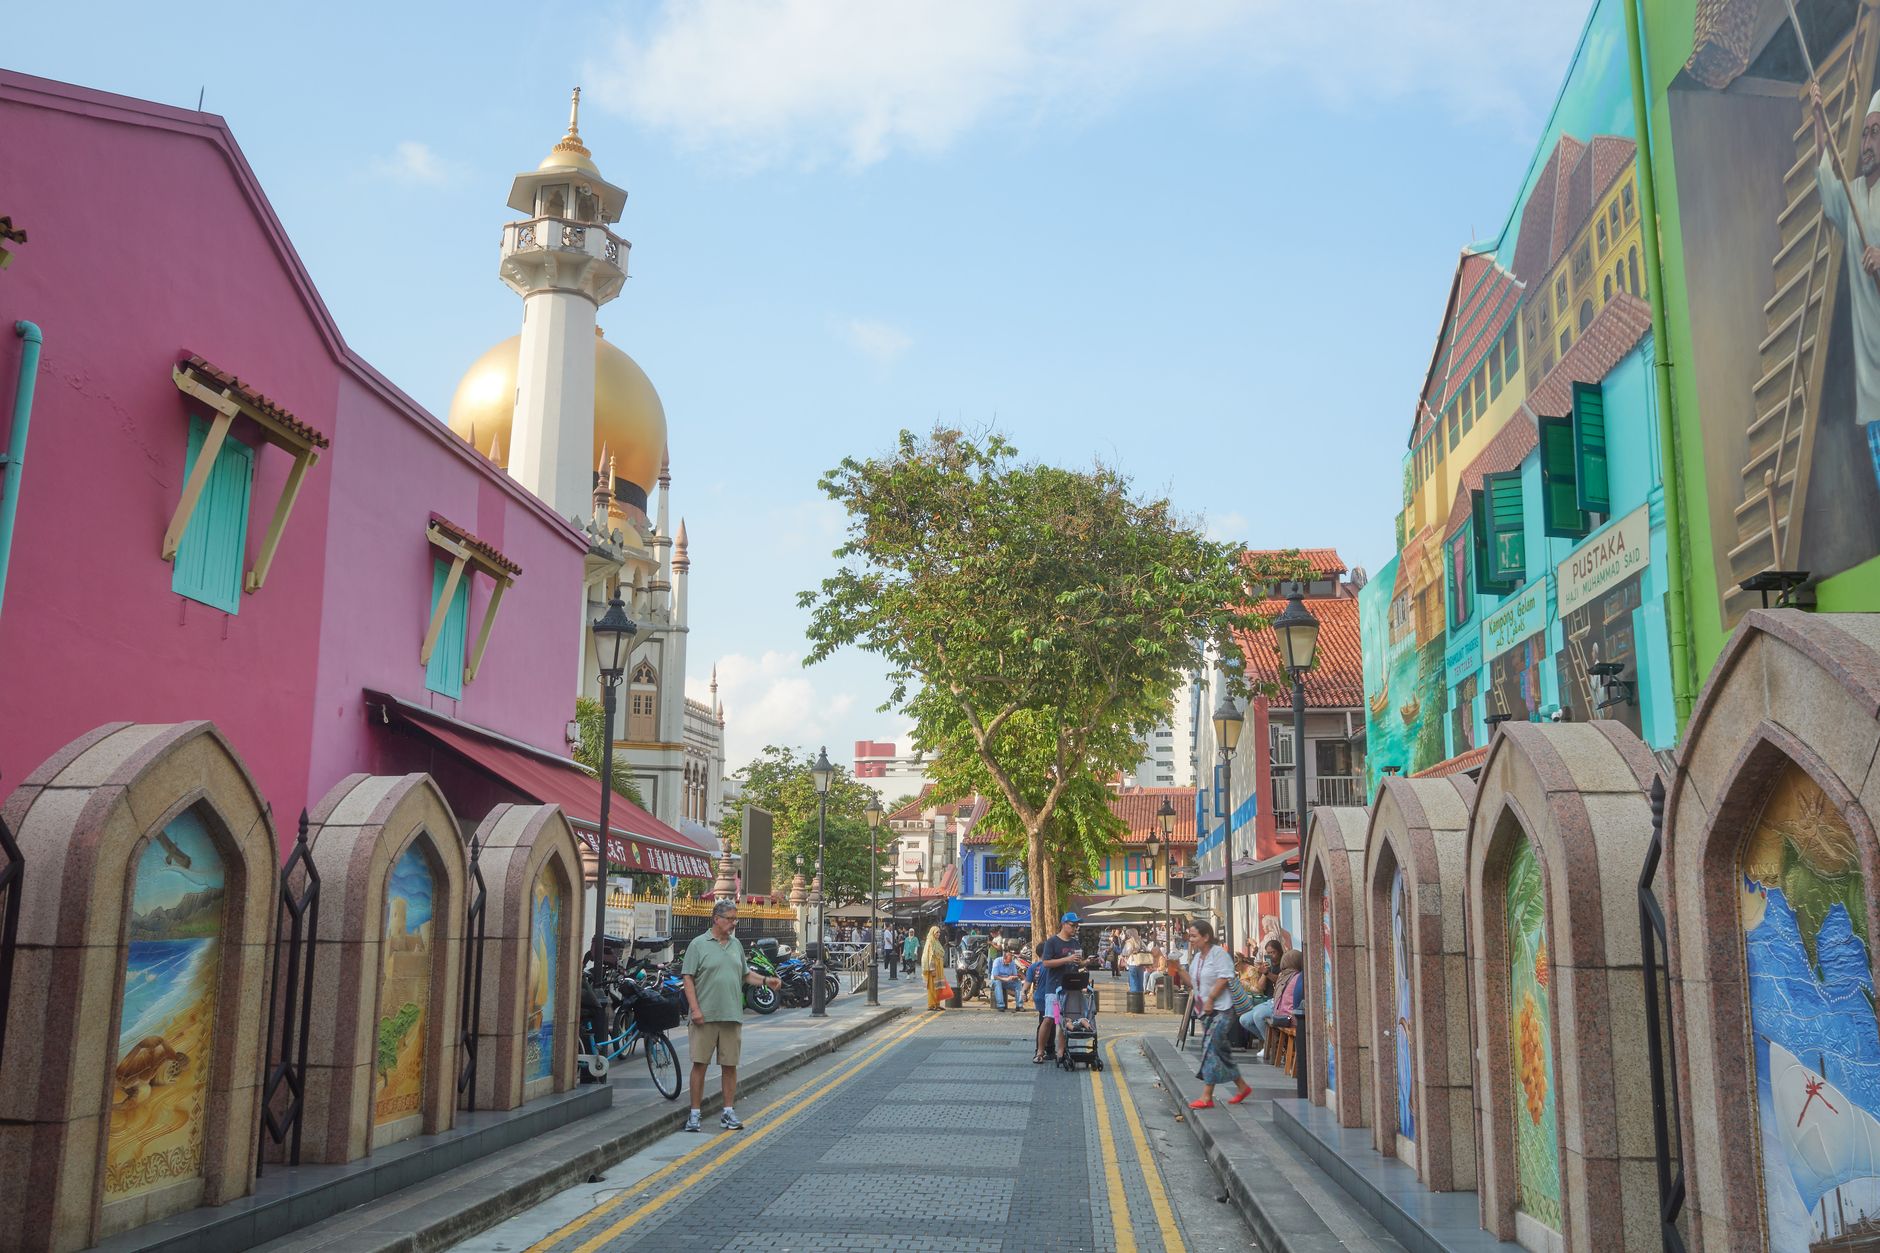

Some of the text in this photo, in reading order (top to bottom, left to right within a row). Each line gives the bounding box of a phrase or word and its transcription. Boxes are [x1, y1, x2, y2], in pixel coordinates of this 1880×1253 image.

[1566, 547, 1640, 604] HAJI MUHAMMAD SAID
[1573, 530, 1625, 584] PUSTAKA
